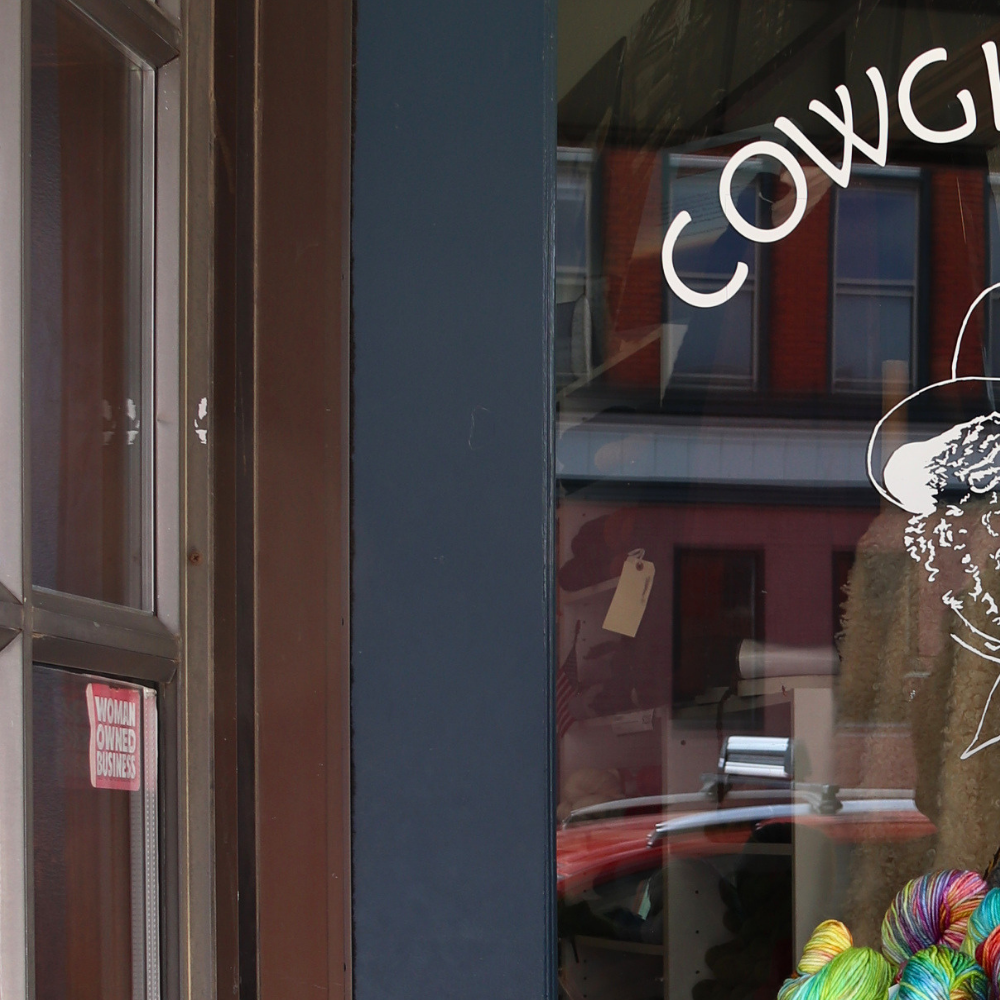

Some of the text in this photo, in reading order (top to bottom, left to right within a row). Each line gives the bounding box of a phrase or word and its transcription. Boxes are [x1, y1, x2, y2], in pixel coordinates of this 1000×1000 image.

[94, 695, 136, 727] WOMAN
[96, 723, 137, 754] OWNED
[96, 750, 136, 779] BUSINESS
